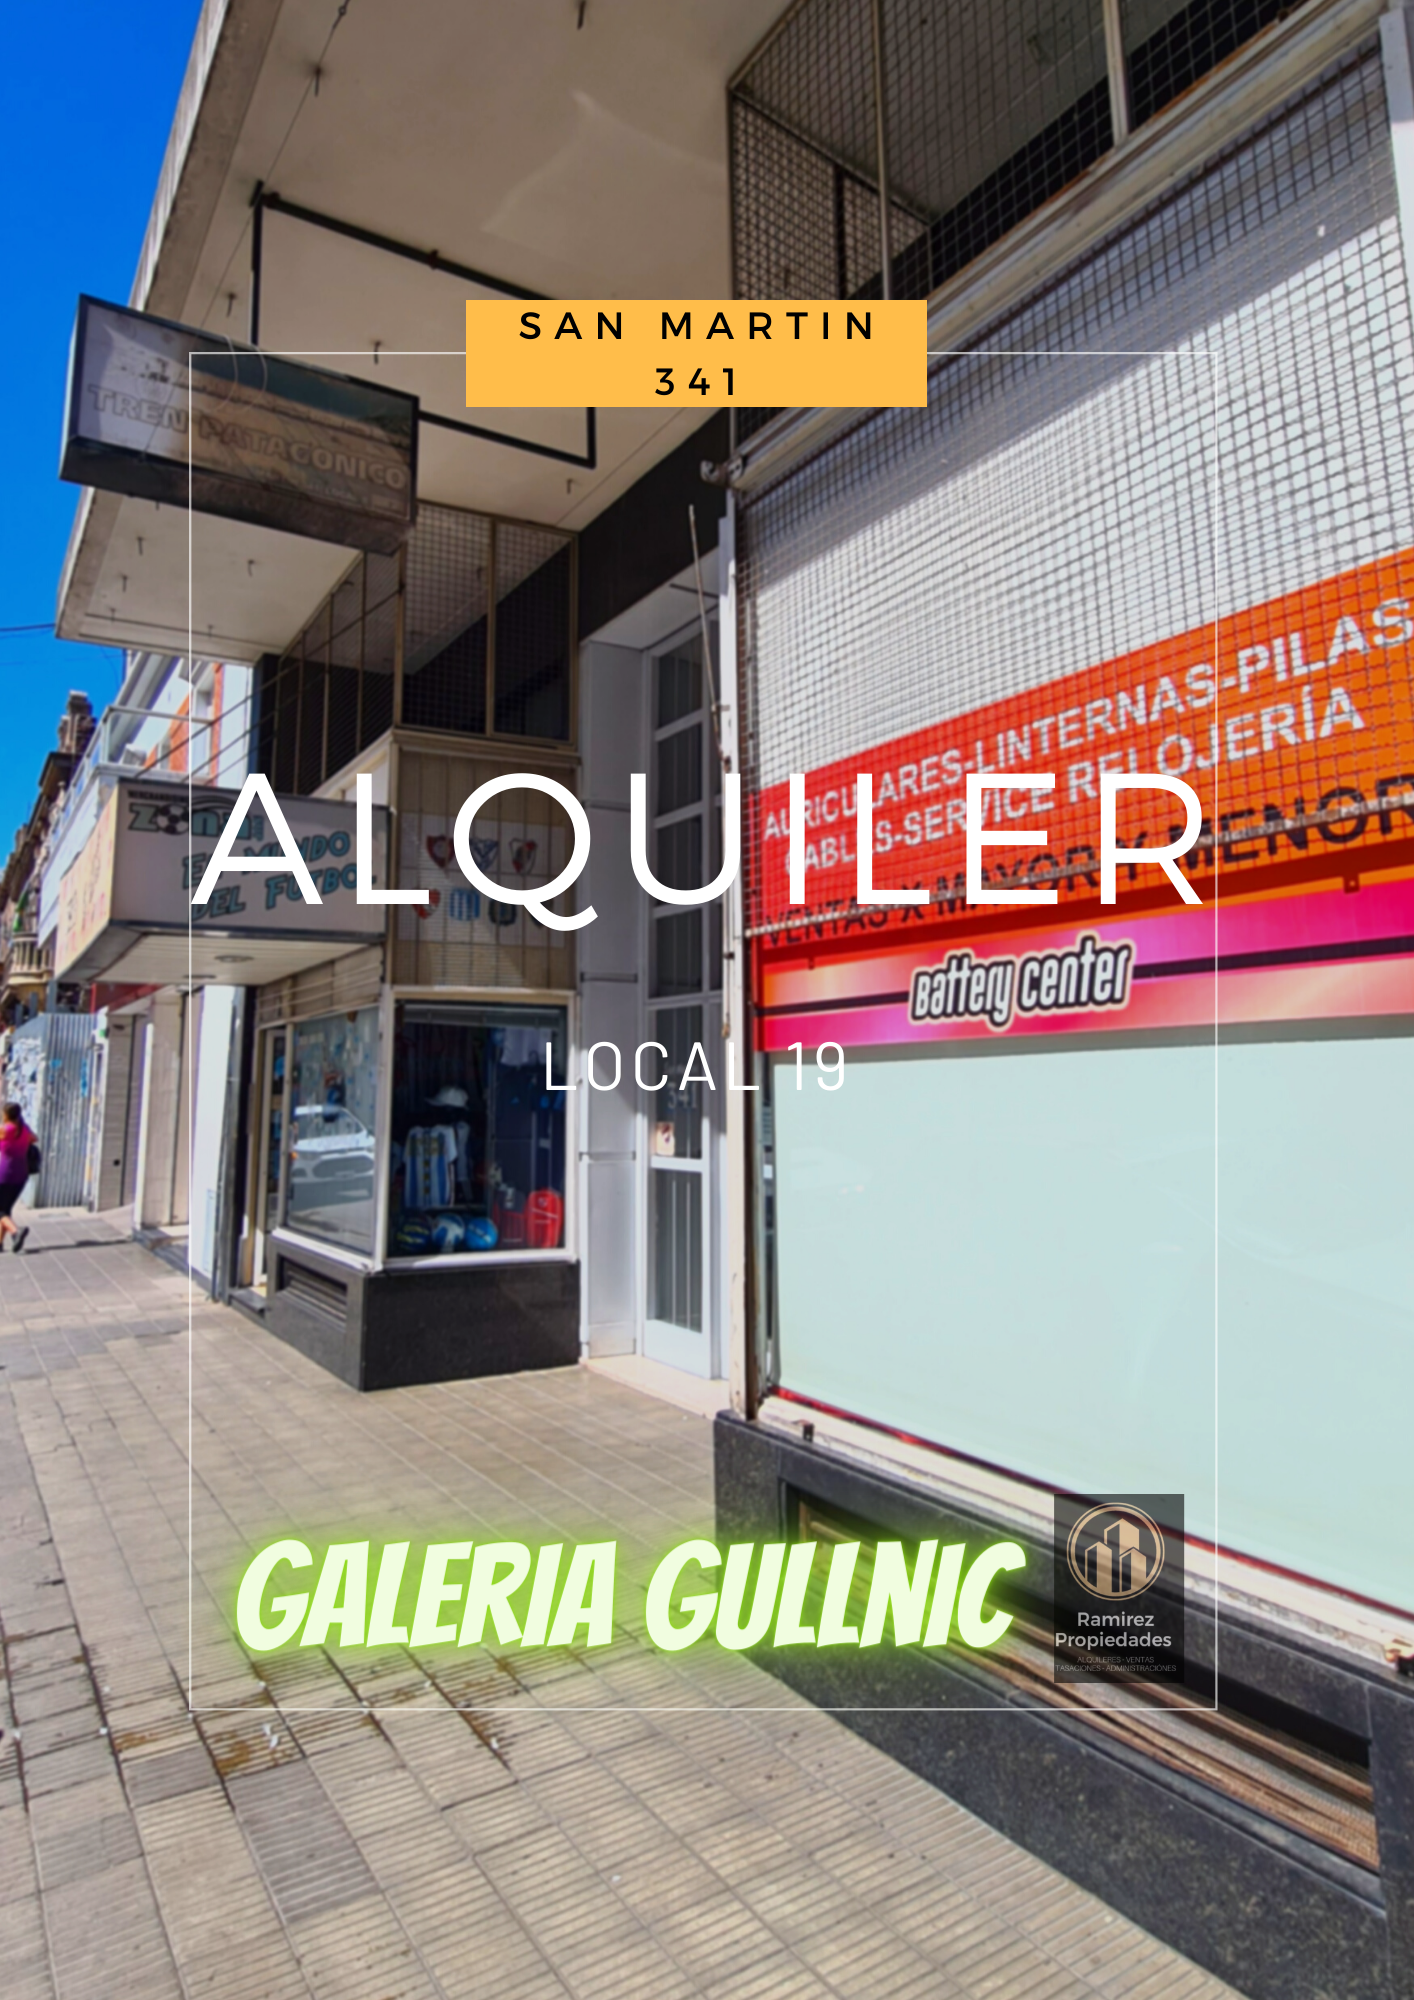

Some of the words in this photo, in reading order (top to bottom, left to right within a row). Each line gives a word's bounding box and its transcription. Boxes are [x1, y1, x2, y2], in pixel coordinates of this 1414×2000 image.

[88, 384, 190, 435] TREN
[763, 597, 1413, 841] AURICUARES-LINTERNAS-PILAS
[265, 862, 378, 910] FUTBO
[1017, 936, 1132, 1011] center
